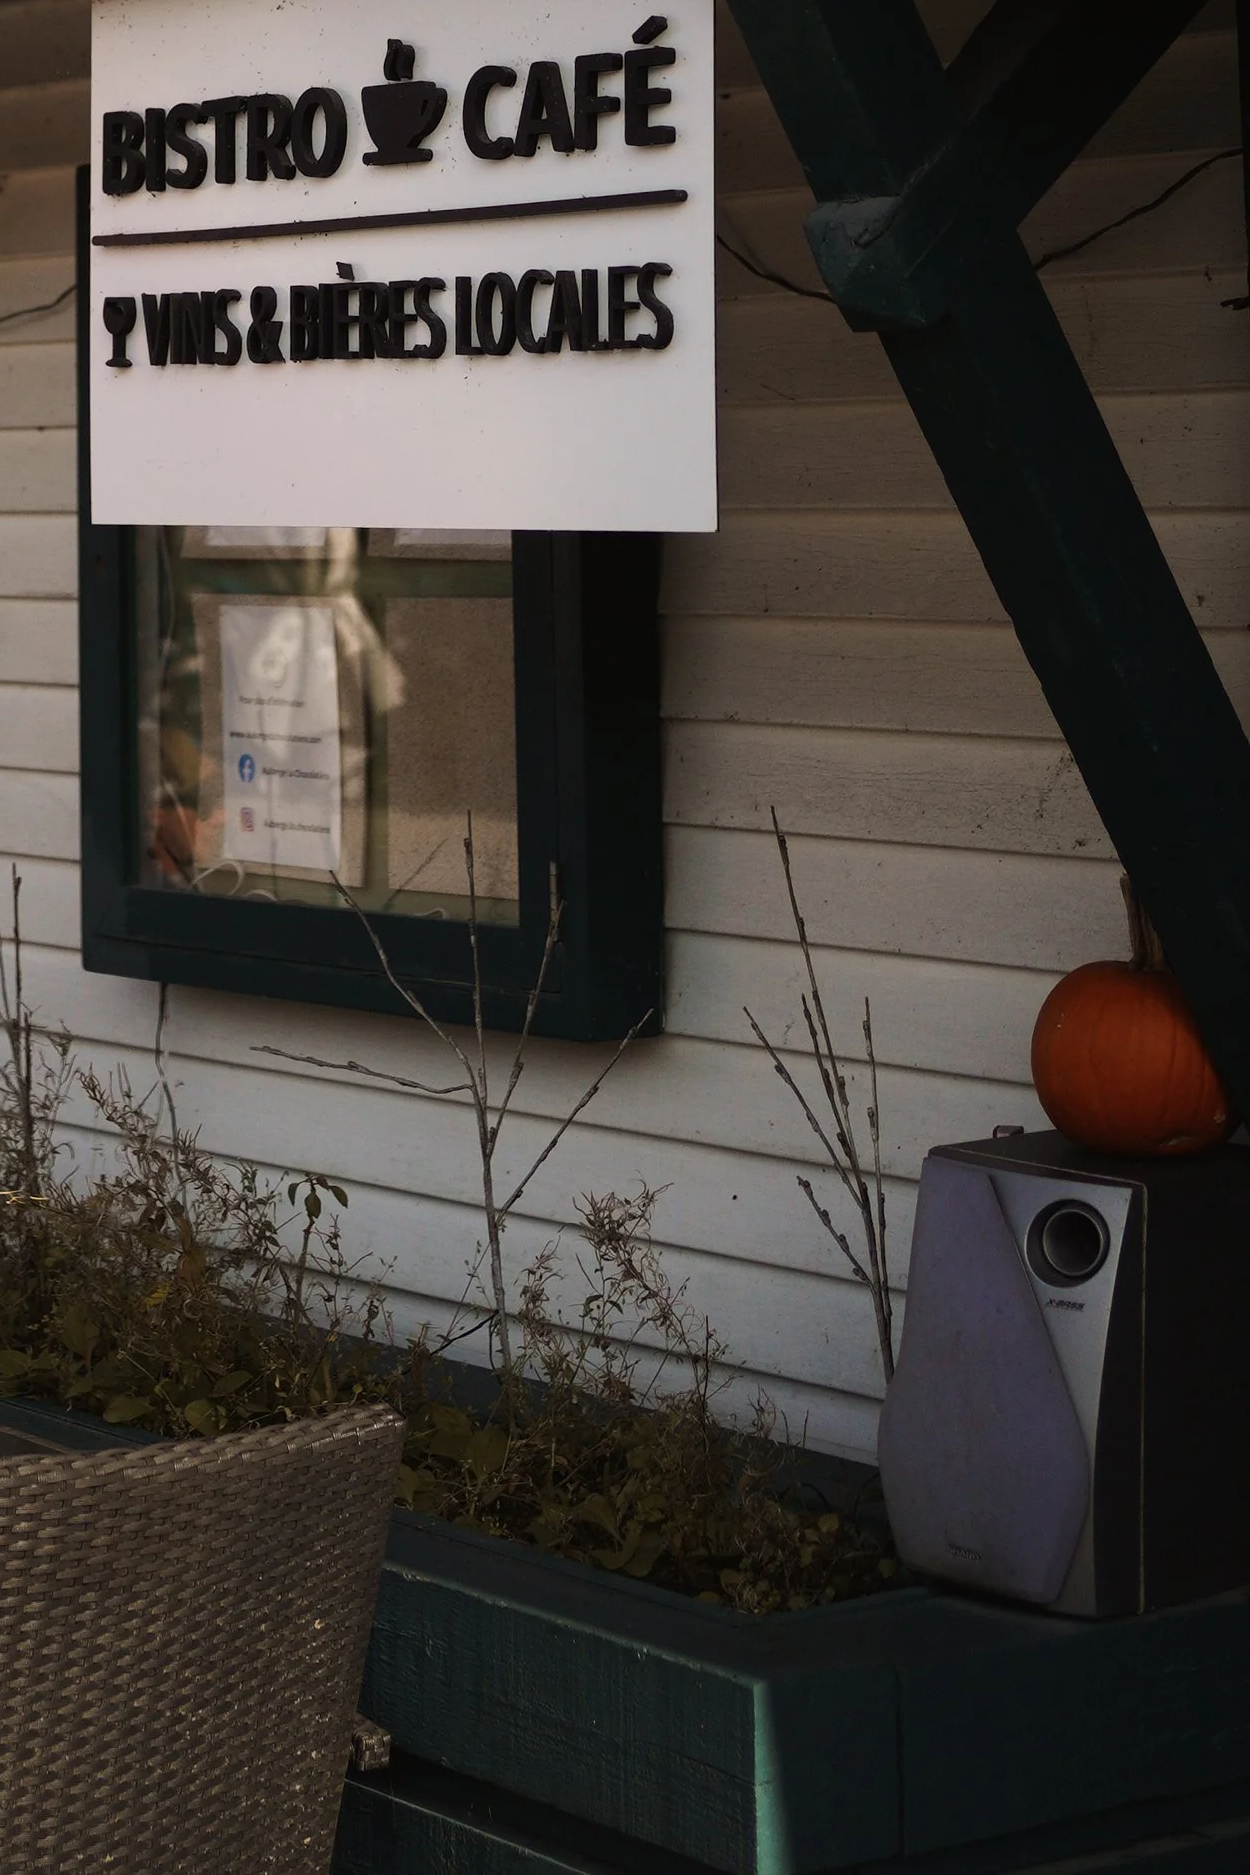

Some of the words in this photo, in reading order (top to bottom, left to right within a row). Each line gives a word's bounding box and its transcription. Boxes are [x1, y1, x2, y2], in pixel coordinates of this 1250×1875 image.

[102, 86, 348, 196] BISTRO
[462, 15, 677, 161] CAFÉ
[142, 288, 243, 367] VINS
[247, 285, 286, 364] &
[289, 261, 448, 362] BIÈRES
[454, 262, 674, 357] LOCALES
